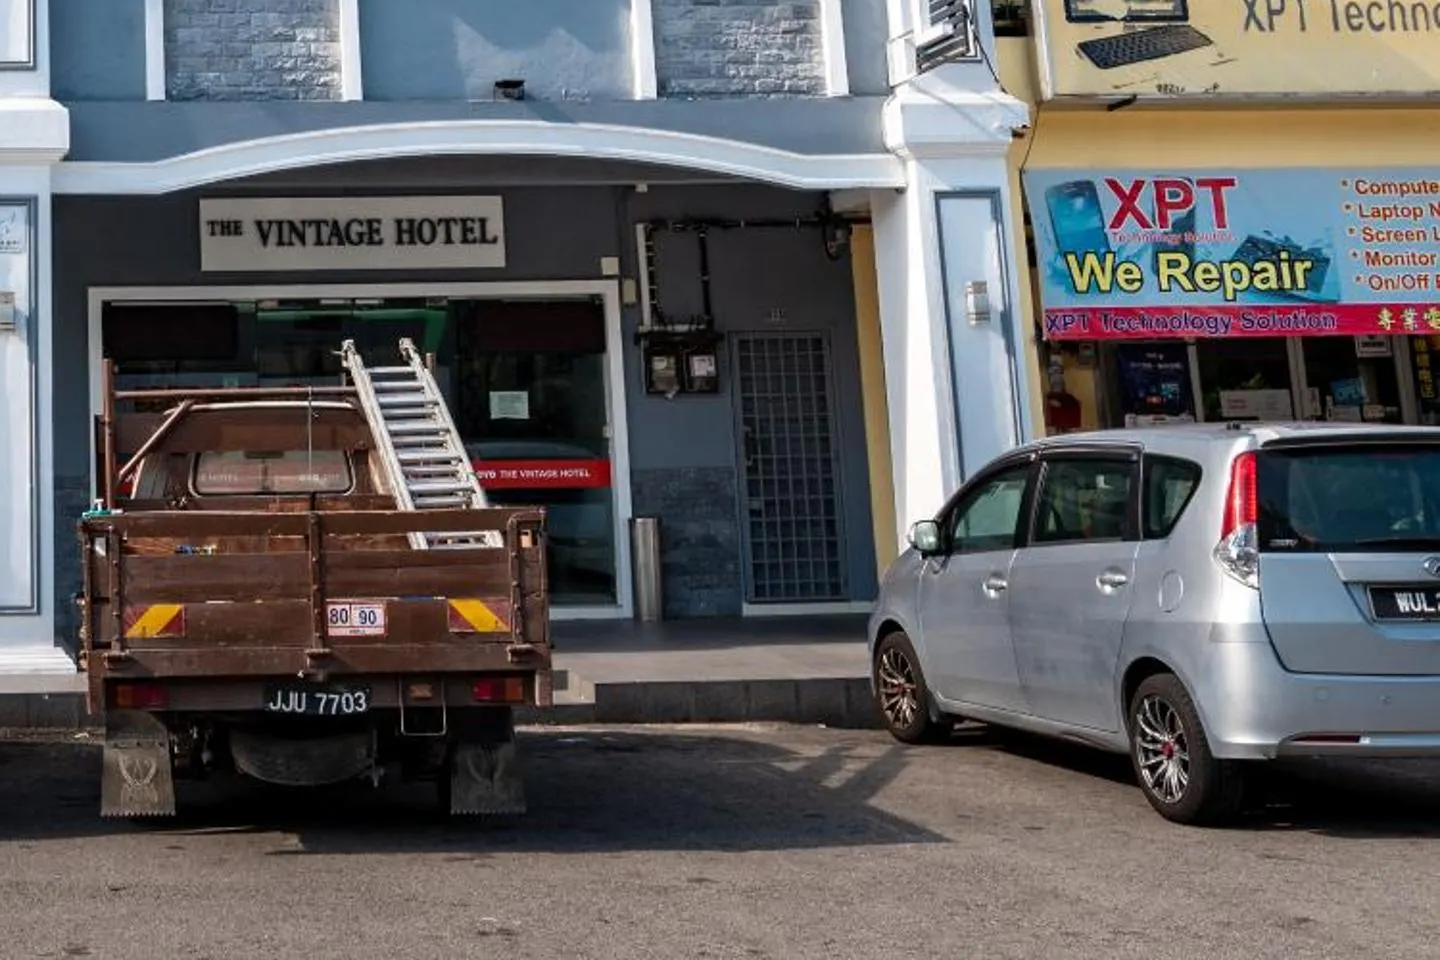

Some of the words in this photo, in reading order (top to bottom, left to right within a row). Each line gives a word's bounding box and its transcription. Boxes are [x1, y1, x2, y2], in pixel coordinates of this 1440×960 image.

[1355, 179, 1440, 197] Compute
[1104, 177, 1237, 230] XPT
[1358, 203, 1424, 221] Laptop
[207, 220, 243, 237] THE
[254, 218, 385, 248] VINTAGE
[394, 217, 499, 246] HOTEL
[1362, 226, 1427, 242] Screen
[1365, 250, 1436, 267] Monitor
[1065, 250, 1143, 293] We
[1157, 250, 1312, 301] Repair
[1368, 274, 1429, 291] On/Off
[1046, 313, 1090, 333] XPT
[1099, 312, 1232, 335] Technology
[1241, 310, 1337, 330] Solution
[500, 470, 517, 479] THE
[520, 469, 558, 478] VINTAGE
[560, 469, 591, 478] HOTEL
[1394, 592, 1436, 612] WUL
[330, 608, 348, 625] 80
[358, 609, 377, 625] 90
[269, 690, 307, 713] JJU
[314, 691, 367, 715] 7703
